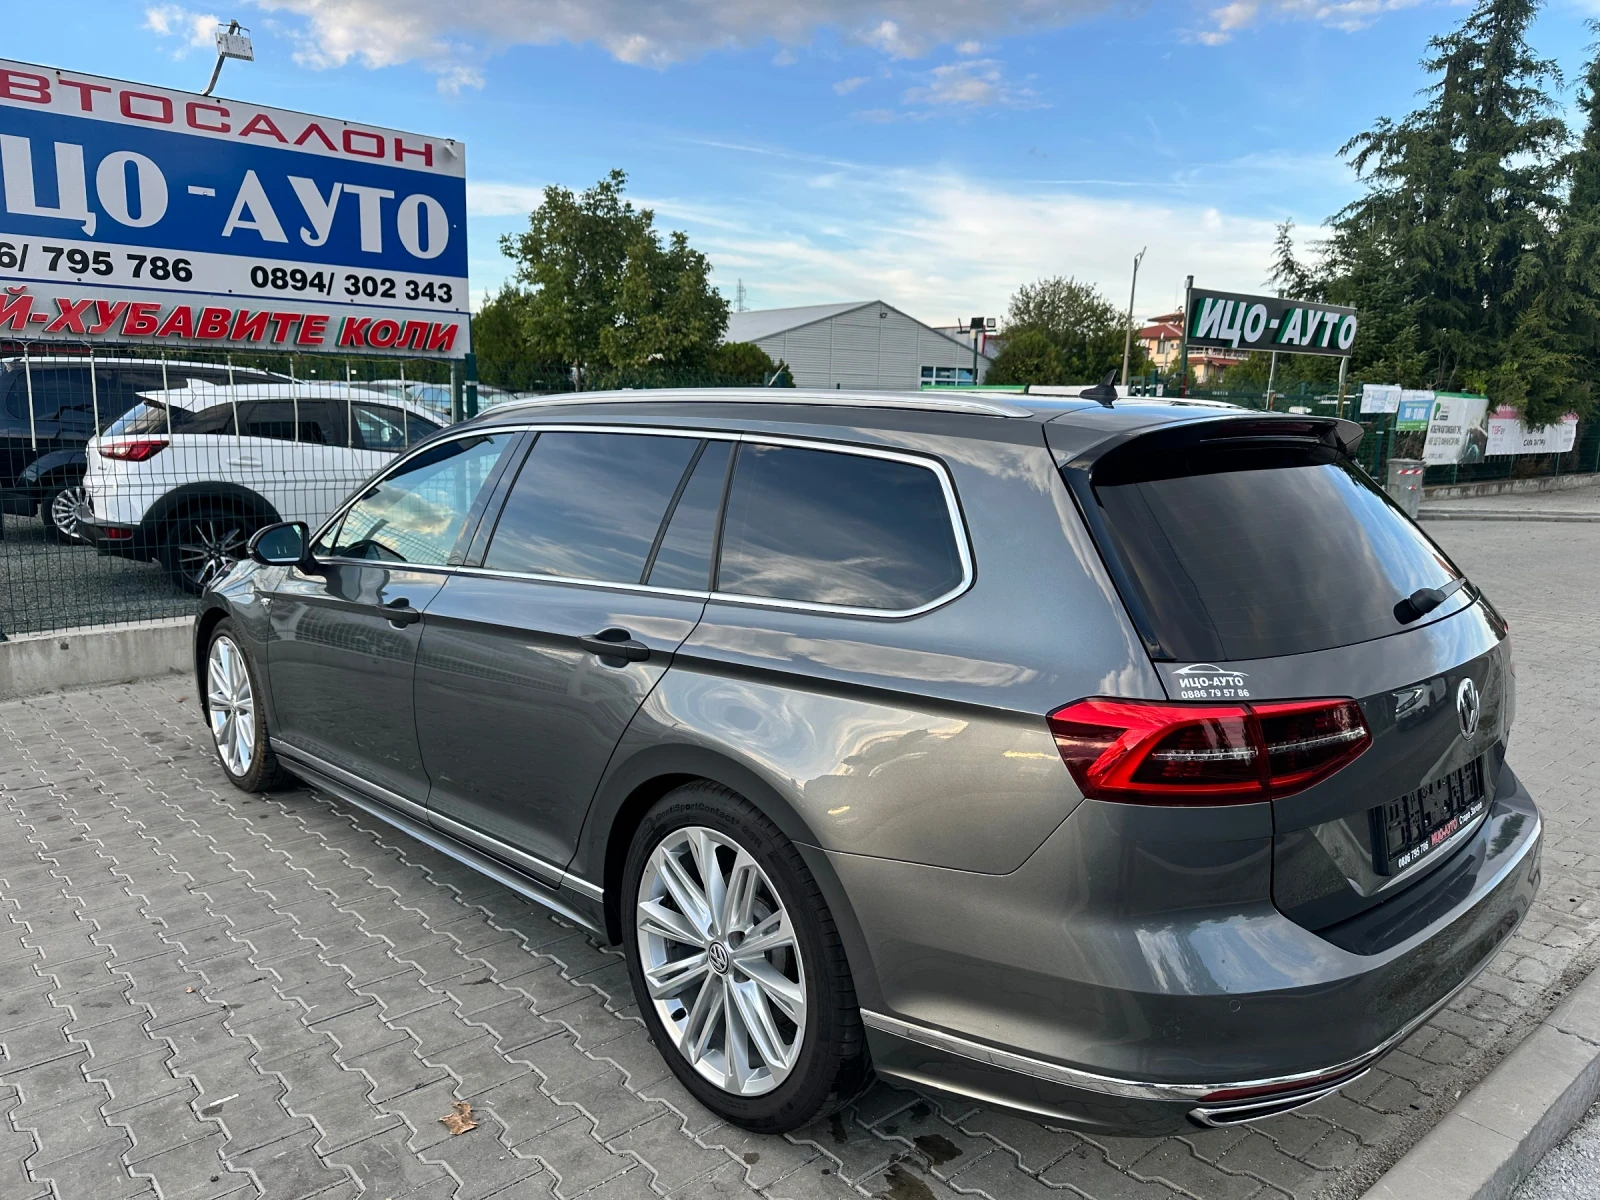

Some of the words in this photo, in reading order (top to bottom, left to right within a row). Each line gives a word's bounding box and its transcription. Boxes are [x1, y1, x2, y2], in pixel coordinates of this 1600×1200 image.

[42, 246, 114, 276] 795
[126, 253, 193, 282] 786
[250, 266, 335, 296] 0894/
[344, 274, 397, 299] 302
[405, 280, 453, 303] 343
[337, 316, 459, 351] КОЛИ
[1194, 298, 1357, 349] ИЦО-АУТО
[1179, 676, 1244, 689] ИЦО-АУТО
[1181, 689, 1207, 699] 0886
[1208, 688, 1221, 697] 79
[1223, 688, 1235, 697] 57
[1237, 688, 1250, 697] 86
